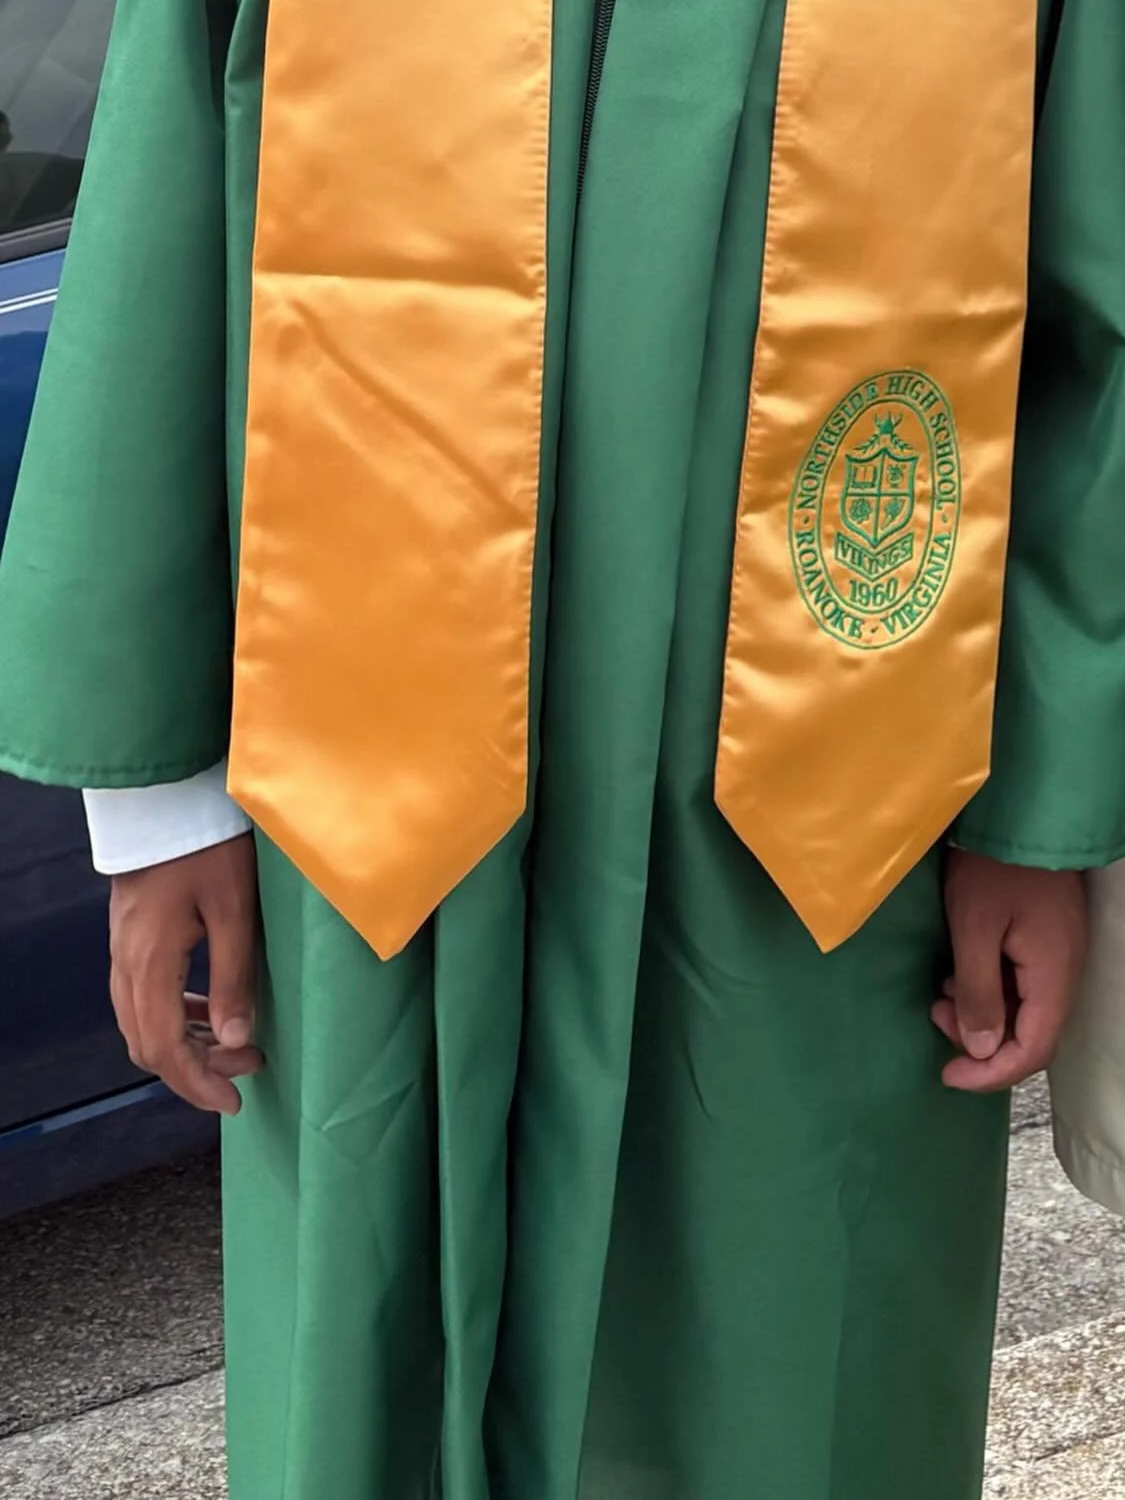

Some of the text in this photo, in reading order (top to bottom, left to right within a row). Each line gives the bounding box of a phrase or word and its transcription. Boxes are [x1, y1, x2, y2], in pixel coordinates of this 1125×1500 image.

[797, 375, 956, 511] NORTHSIDE HIGH SCHOOL
[796, 530, 951, 638] ROANOKE VIRGINIA
[839, 541, 912, 574] VIKINGS
[848, 578, 900, 606] 1960
